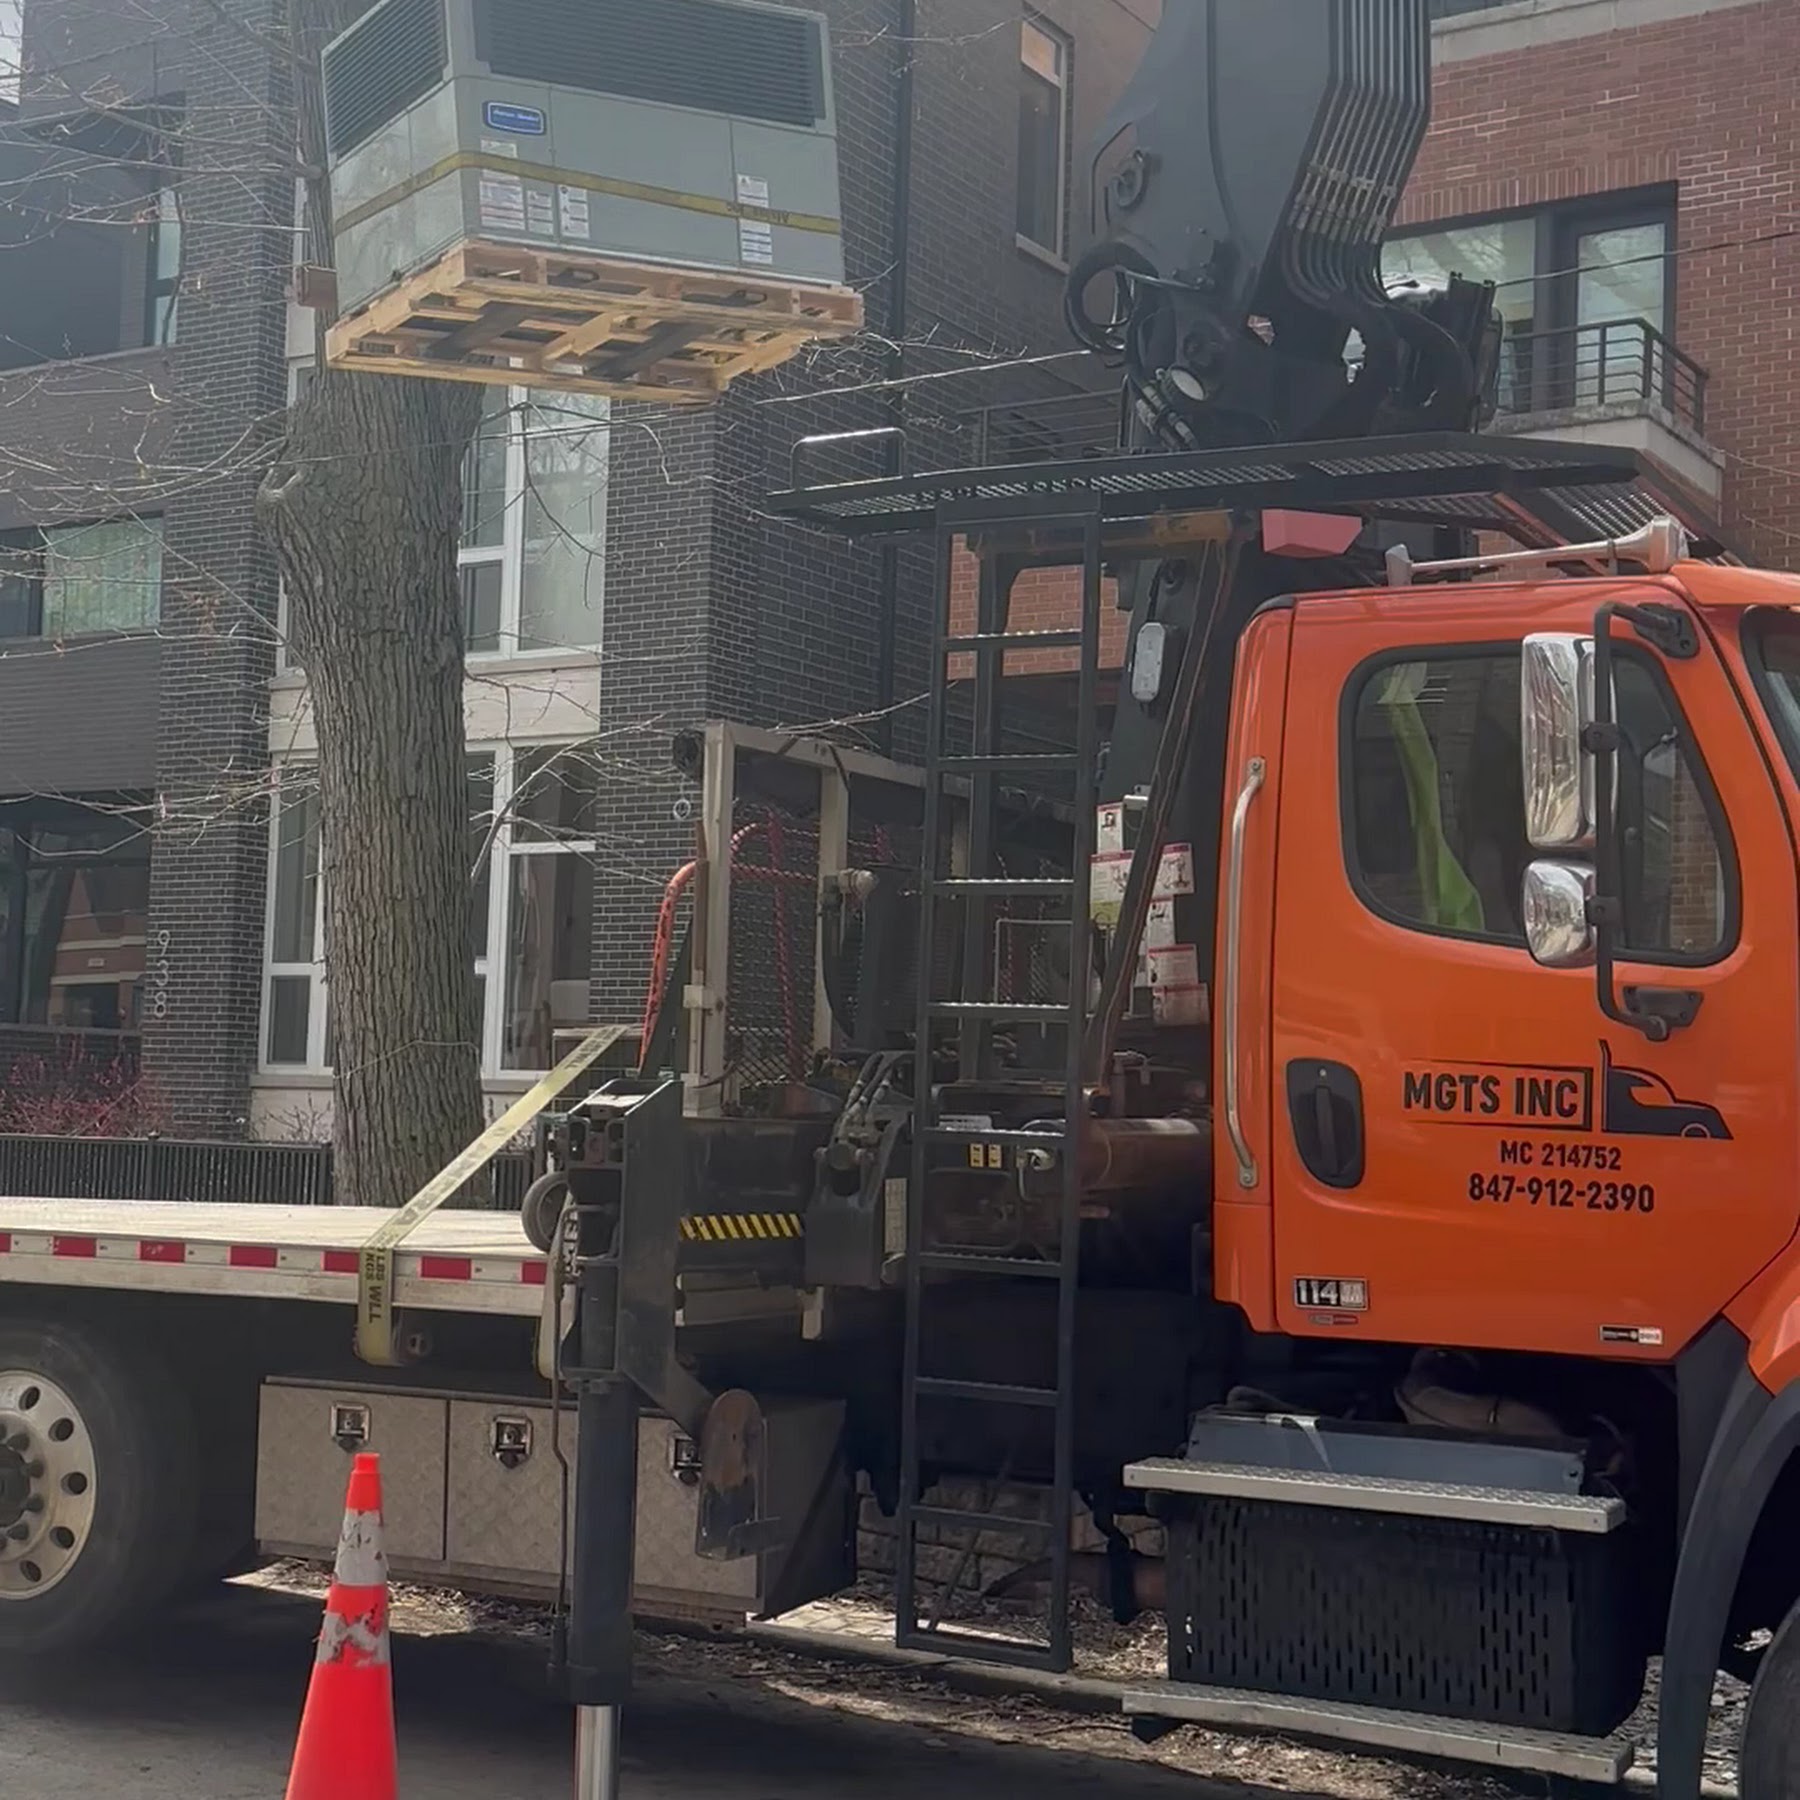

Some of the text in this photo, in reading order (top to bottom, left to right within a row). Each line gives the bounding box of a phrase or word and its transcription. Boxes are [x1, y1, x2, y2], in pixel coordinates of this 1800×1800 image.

[154, 929, 170, 1019] 938
[1403, 1071, 1578, 1118] MGTS INC
[1500, 1140, 1622, 1171] MC 214752
[1468, 1173, 1655, 1213] 847-912-2390
[369, 1286, 382, 1324] WLL
